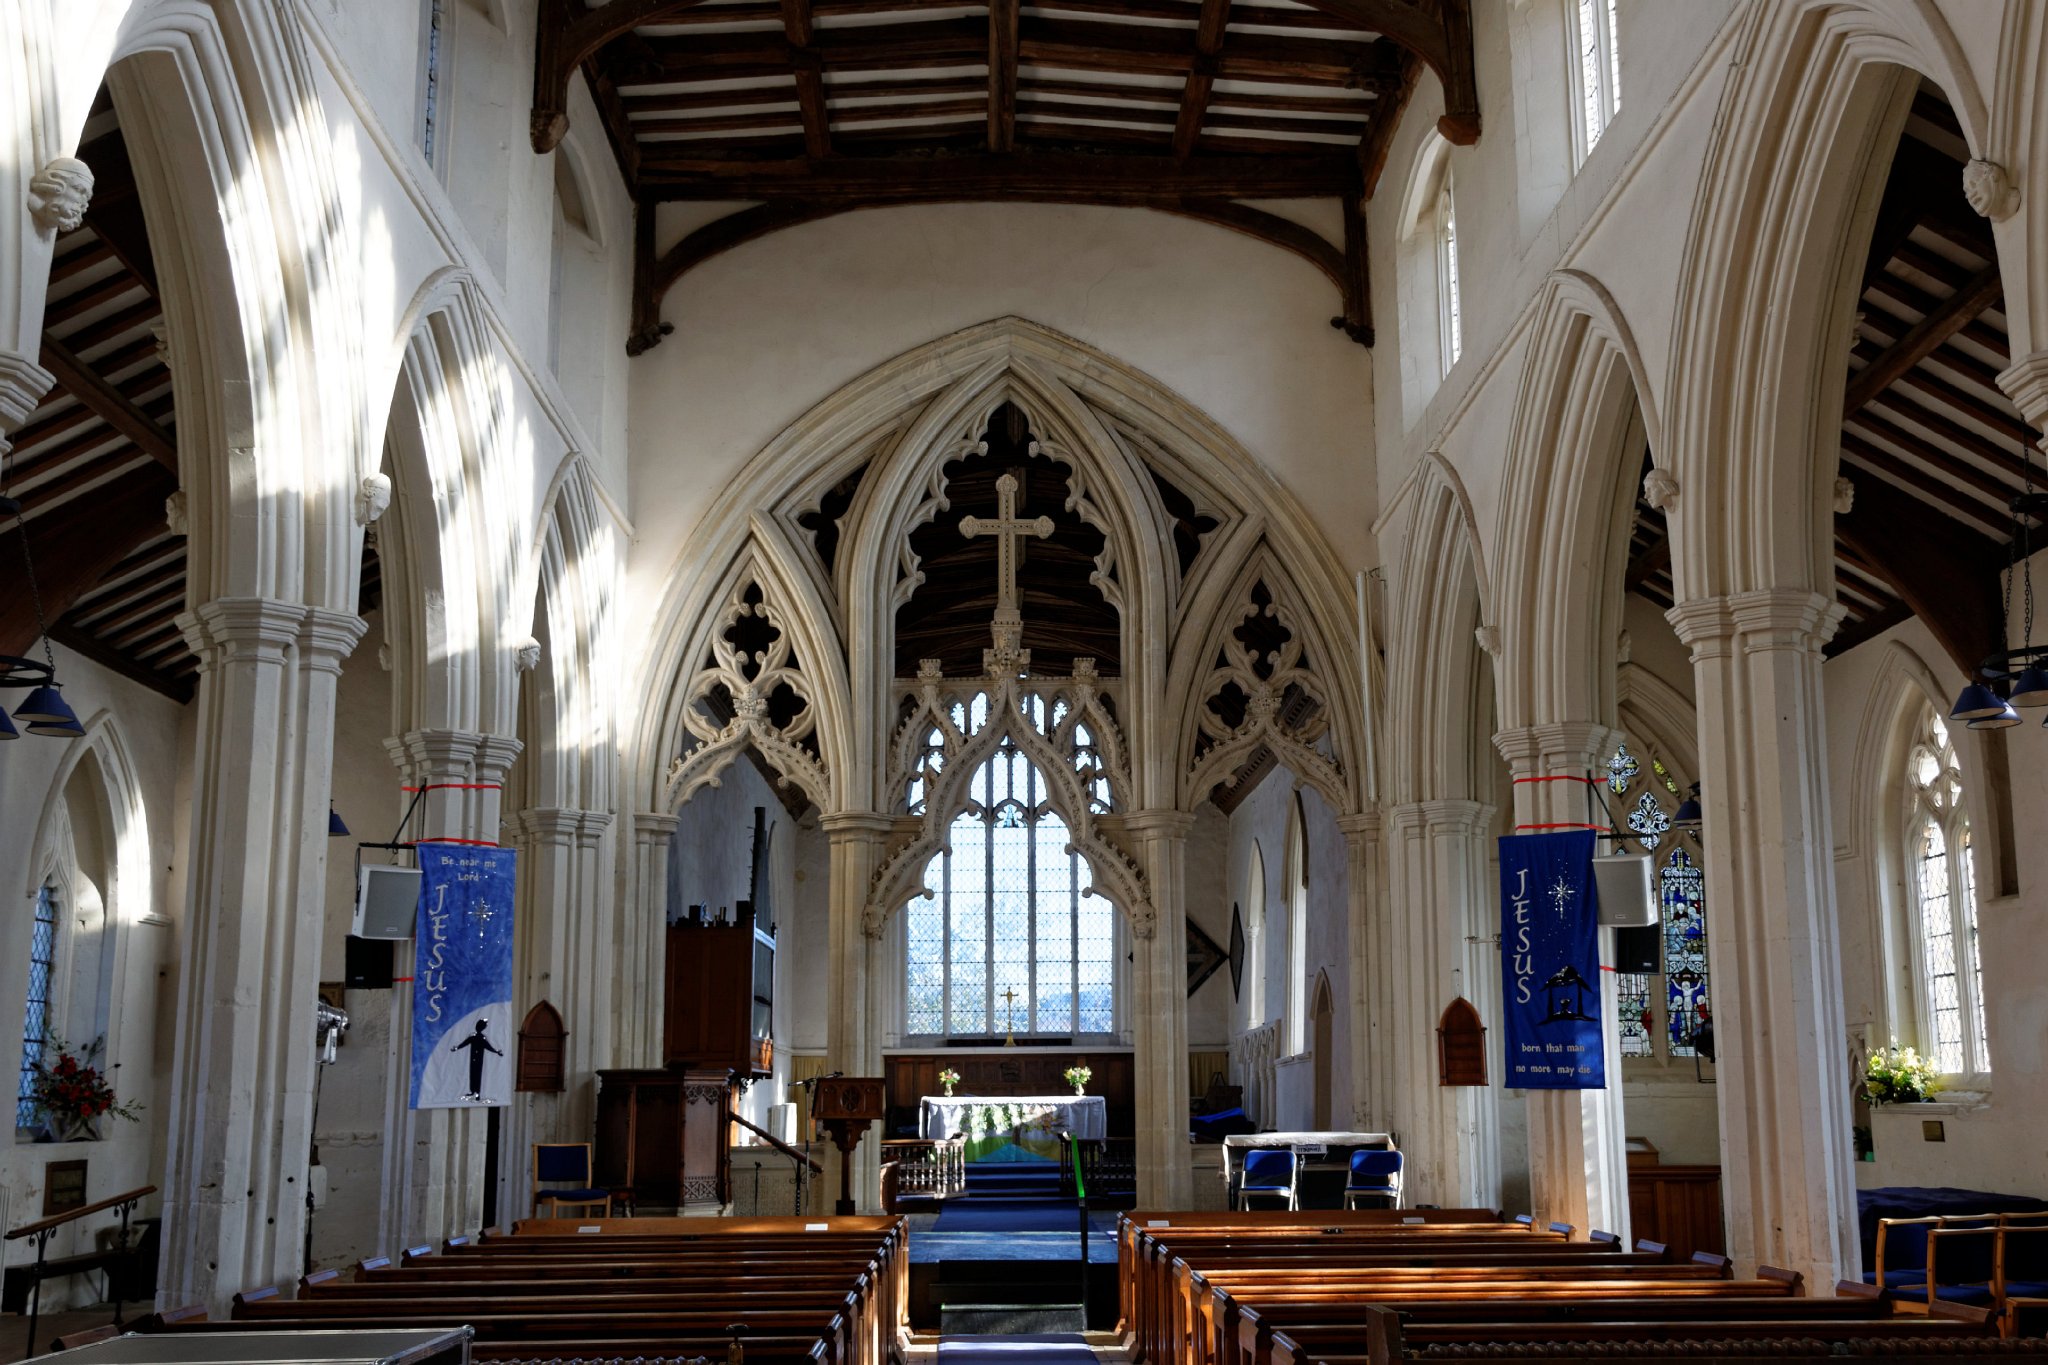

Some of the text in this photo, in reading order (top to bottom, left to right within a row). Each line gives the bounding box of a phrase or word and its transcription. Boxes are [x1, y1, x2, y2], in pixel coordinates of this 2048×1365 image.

[441, 856, 497, 869] Be near me
[457, 872, 480, 882] Lord
[1511, 868, 1535, 1004] JESUS
[424, 884, 449, 1022] JESUS
[1521, 1042, 1585, 1053] born that man
[1515, 1064, 1592, 1077] no more may die
